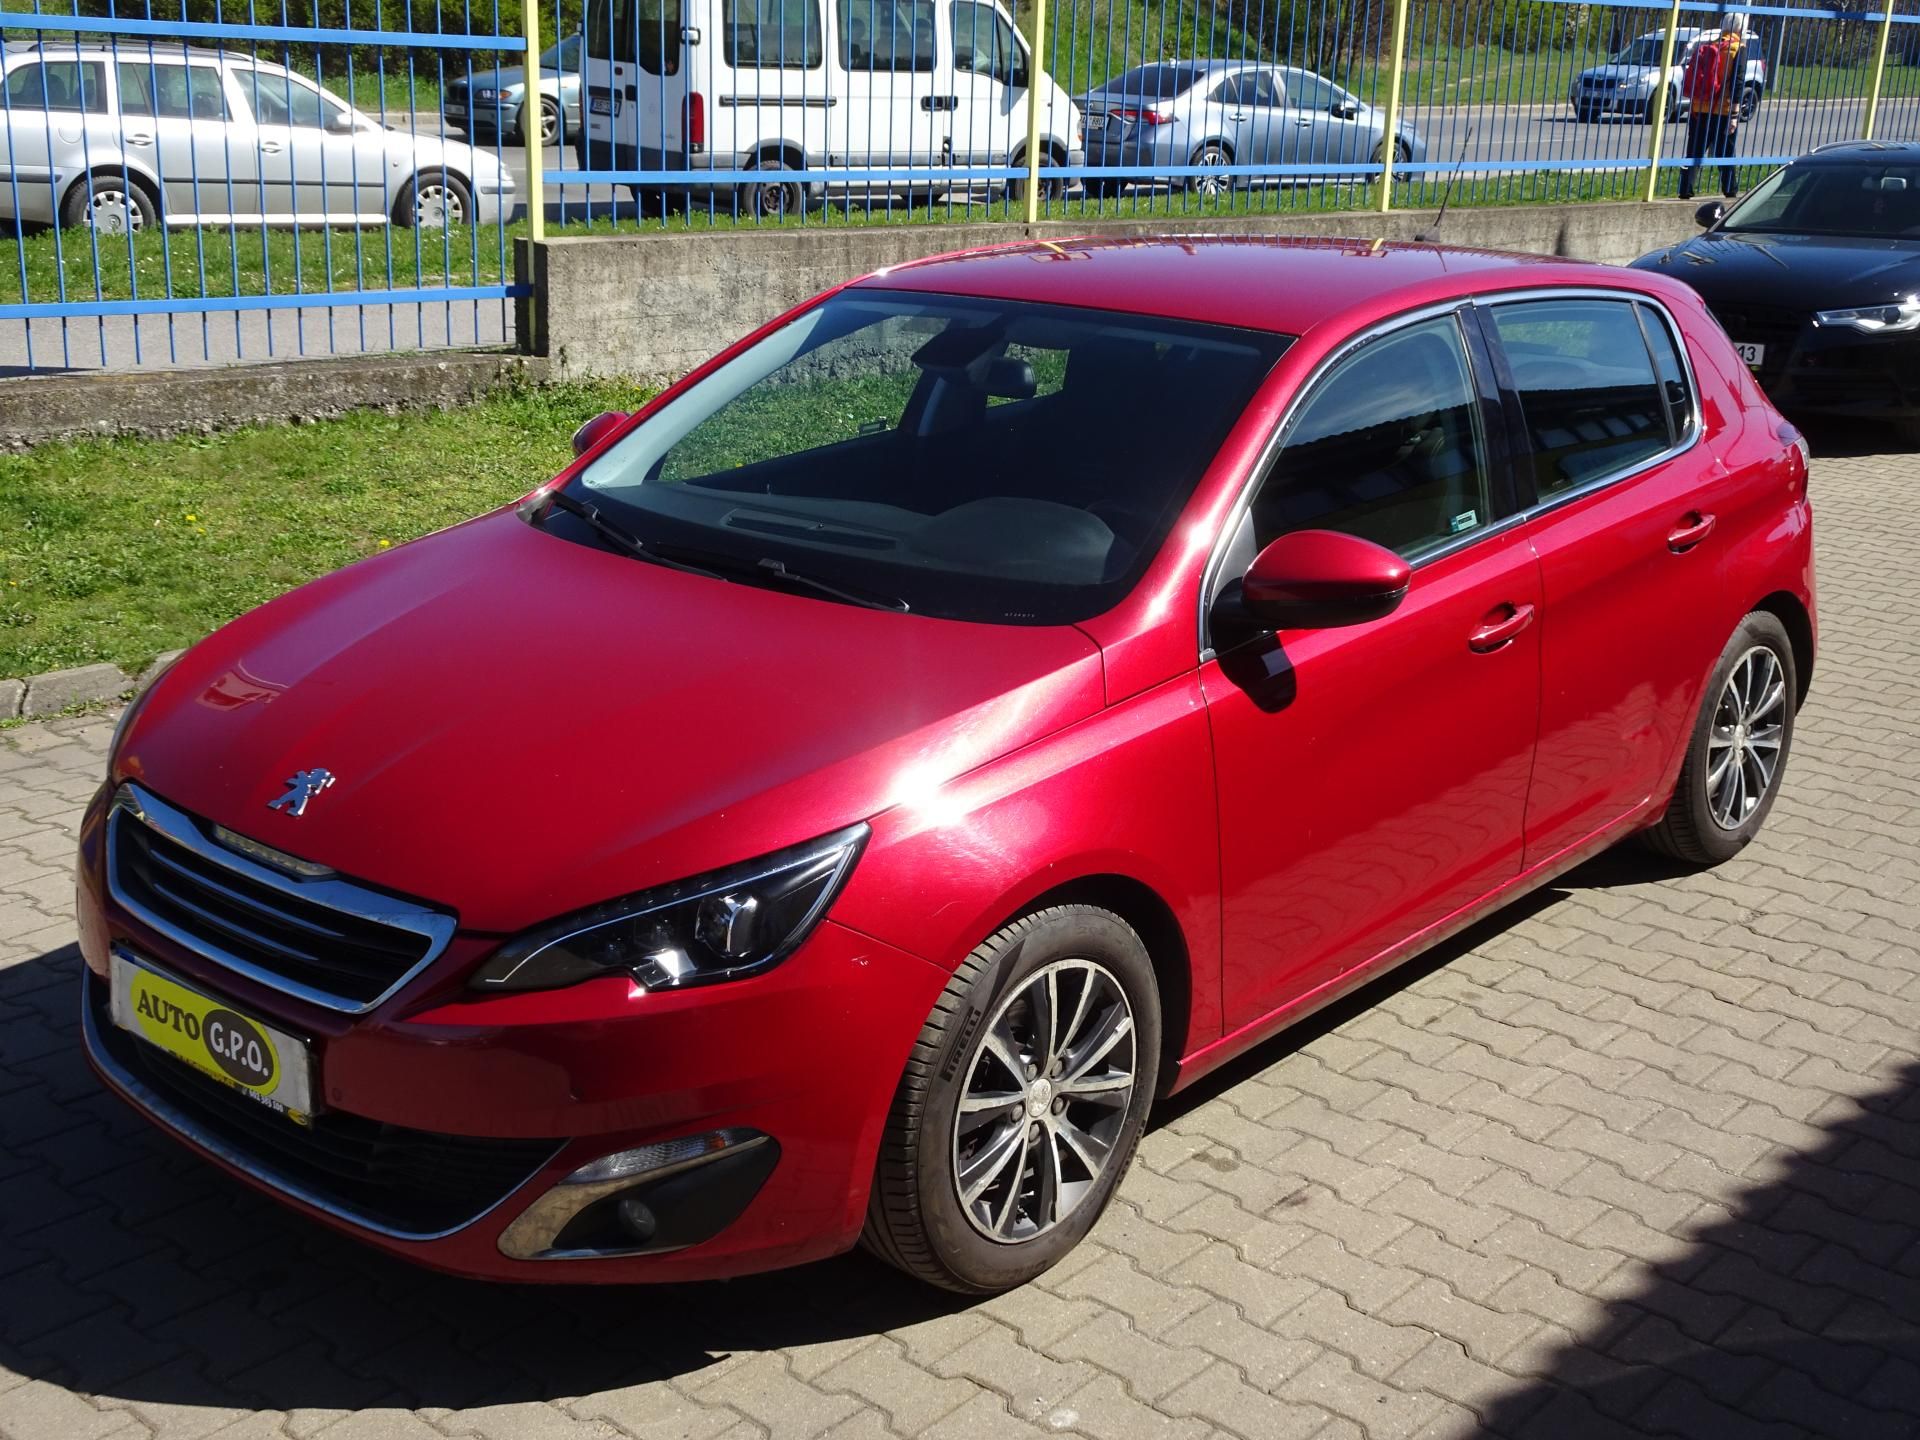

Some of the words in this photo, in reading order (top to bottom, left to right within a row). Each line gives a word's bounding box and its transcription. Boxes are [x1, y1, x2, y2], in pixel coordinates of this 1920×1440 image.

[136, 988, 200, 1041] AUTO
[209, 1021, 269, 1077] G.P.O.
[939, 1006, 981, 1082] PIRELLI
